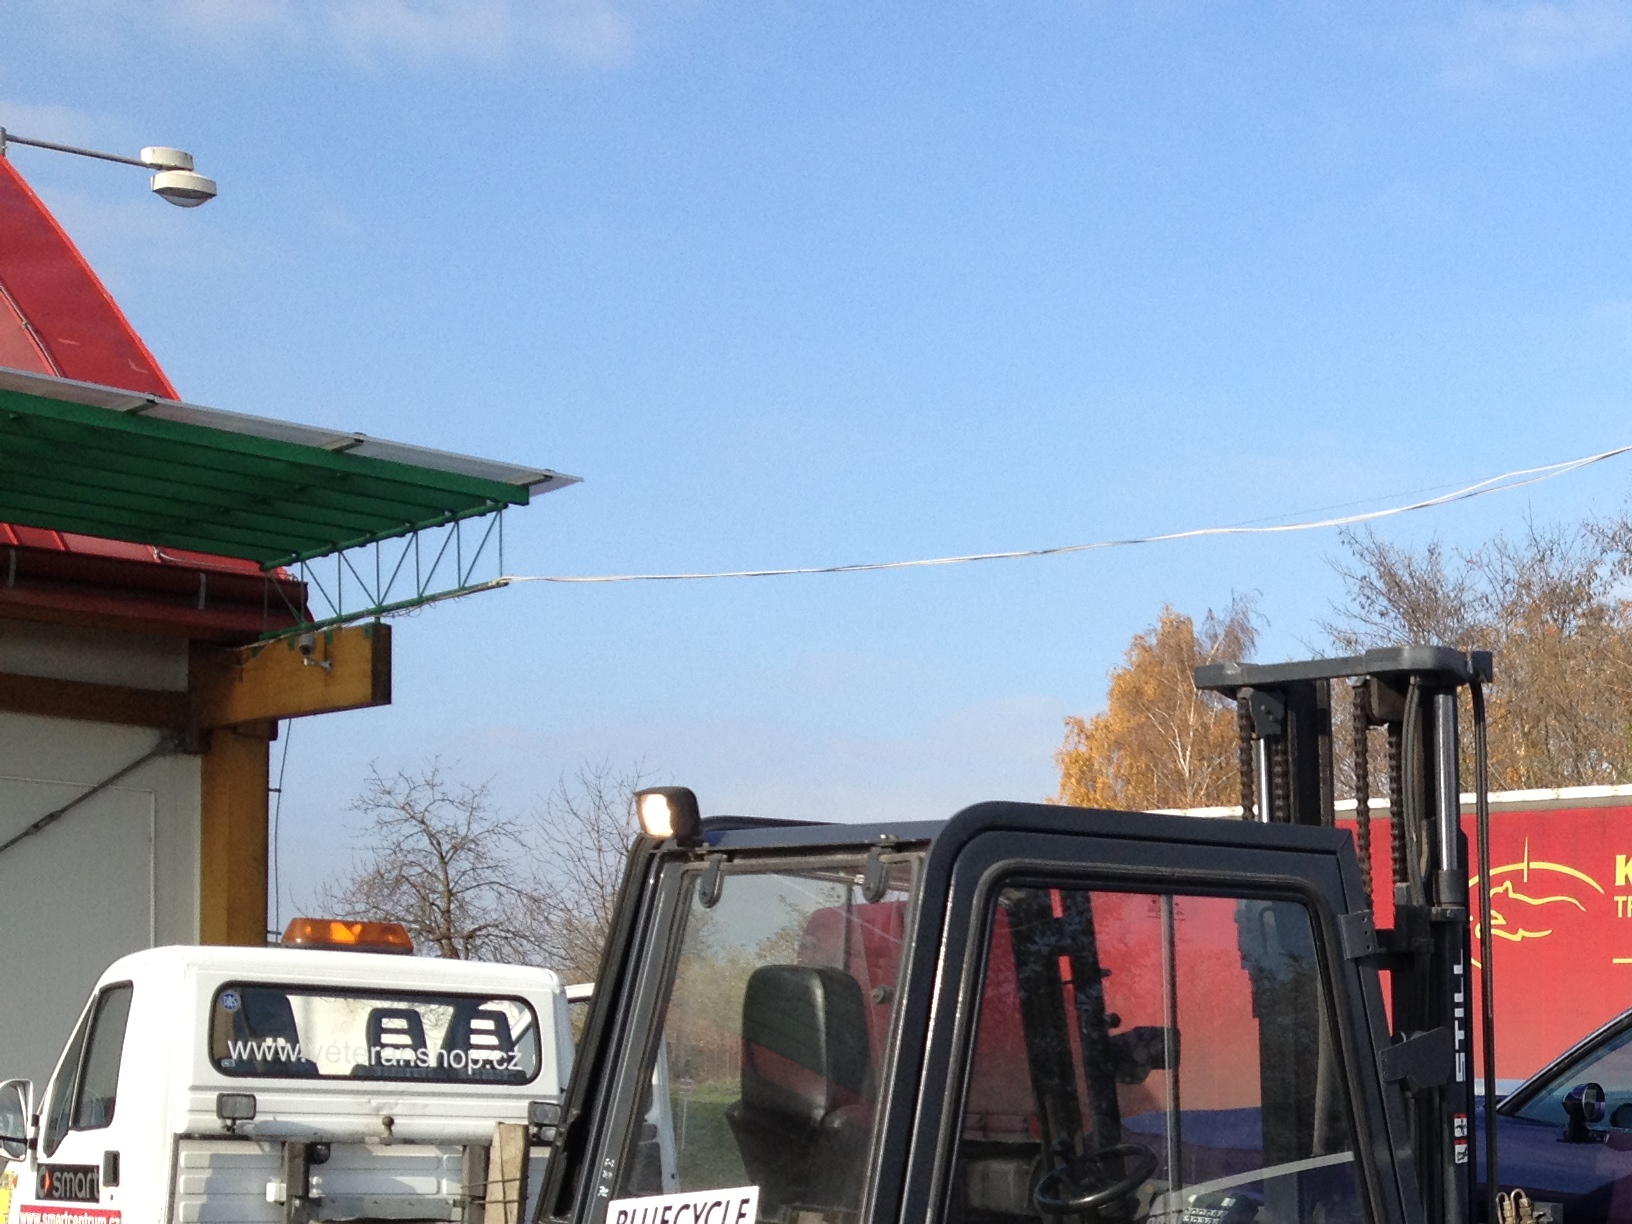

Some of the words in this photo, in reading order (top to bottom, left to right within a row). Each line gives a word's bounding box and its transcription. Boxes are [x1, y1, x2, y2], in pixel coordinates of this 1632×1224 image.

[1453, 948, 1466, 1082] STILL
[227, 1039, 523, 1075] www.veteranshop.cz
[52, 1167, 99, 1199] smart
